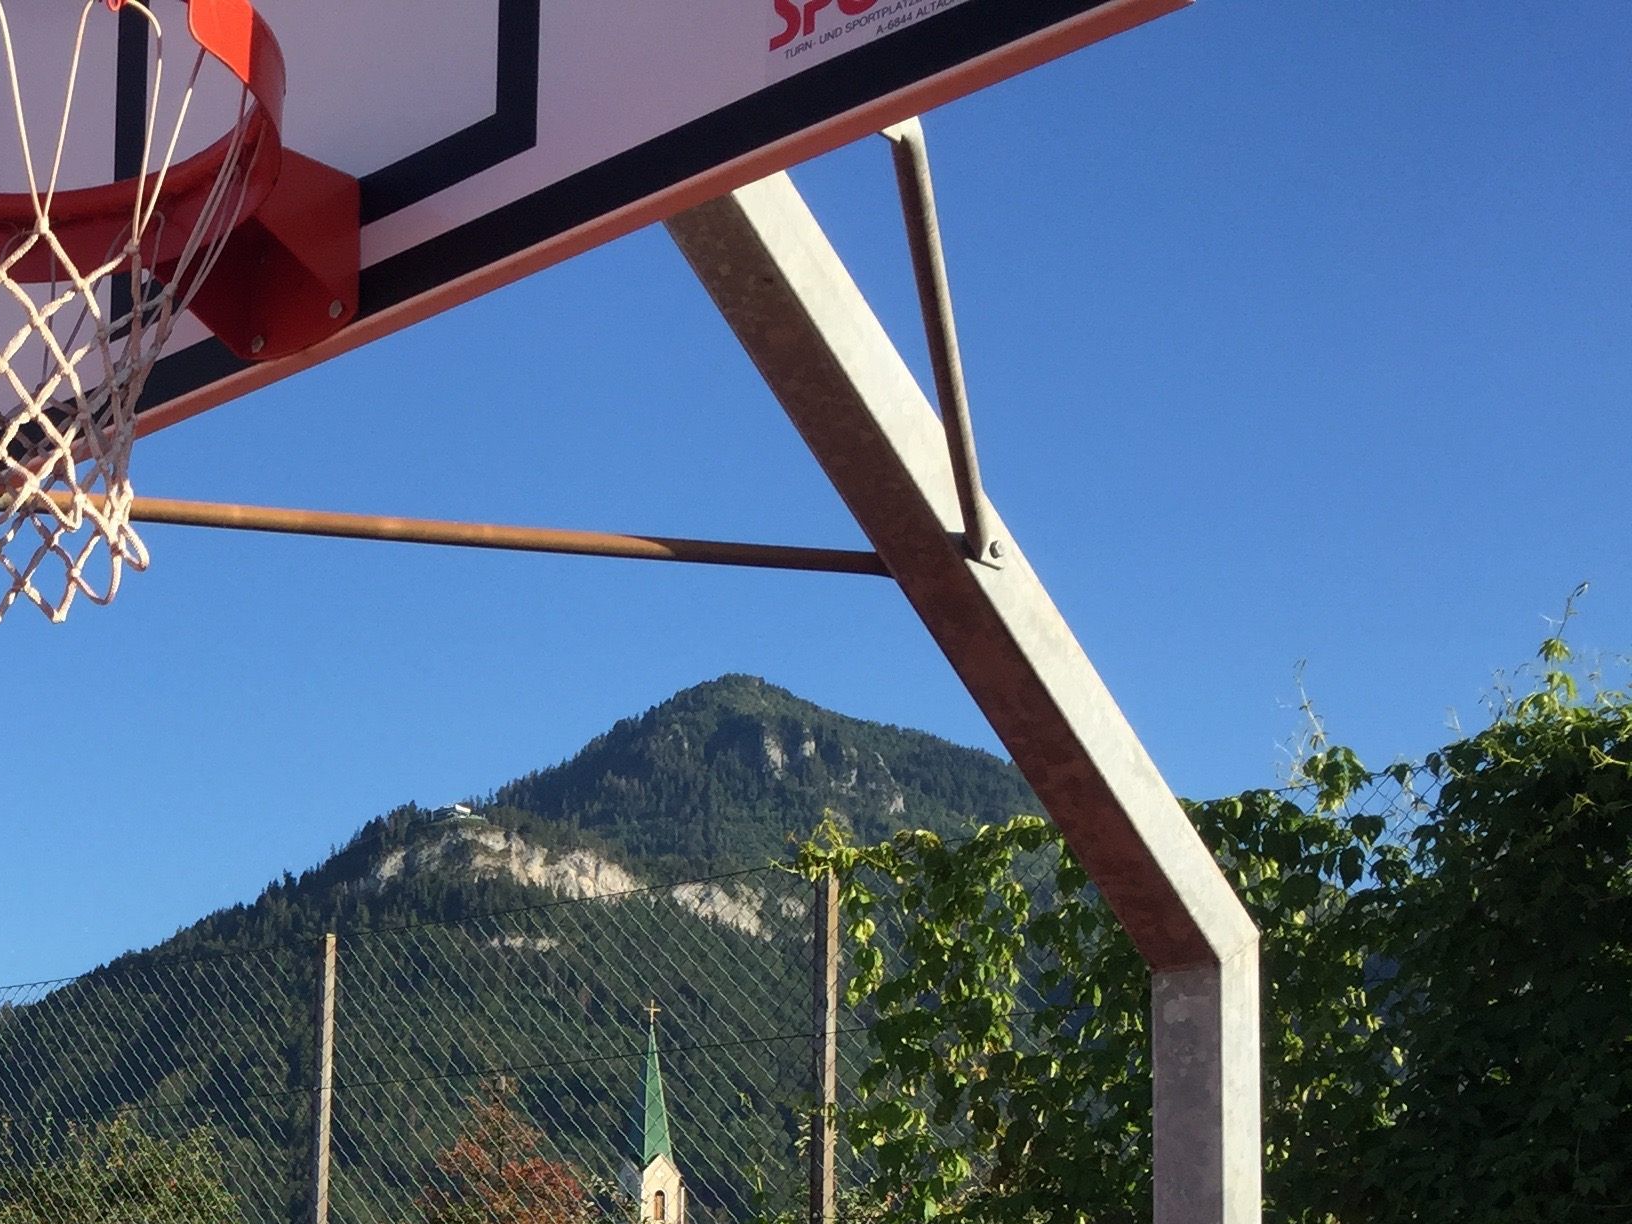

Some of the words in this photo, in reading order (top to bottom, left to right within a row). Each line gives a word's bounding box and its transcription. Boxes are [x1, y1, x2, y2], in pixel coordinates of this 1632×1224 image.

[876, 12, 913, 35] A-6844
[784, 40, 817, 59] TURN-
[819, 26, 843, 44] UND
